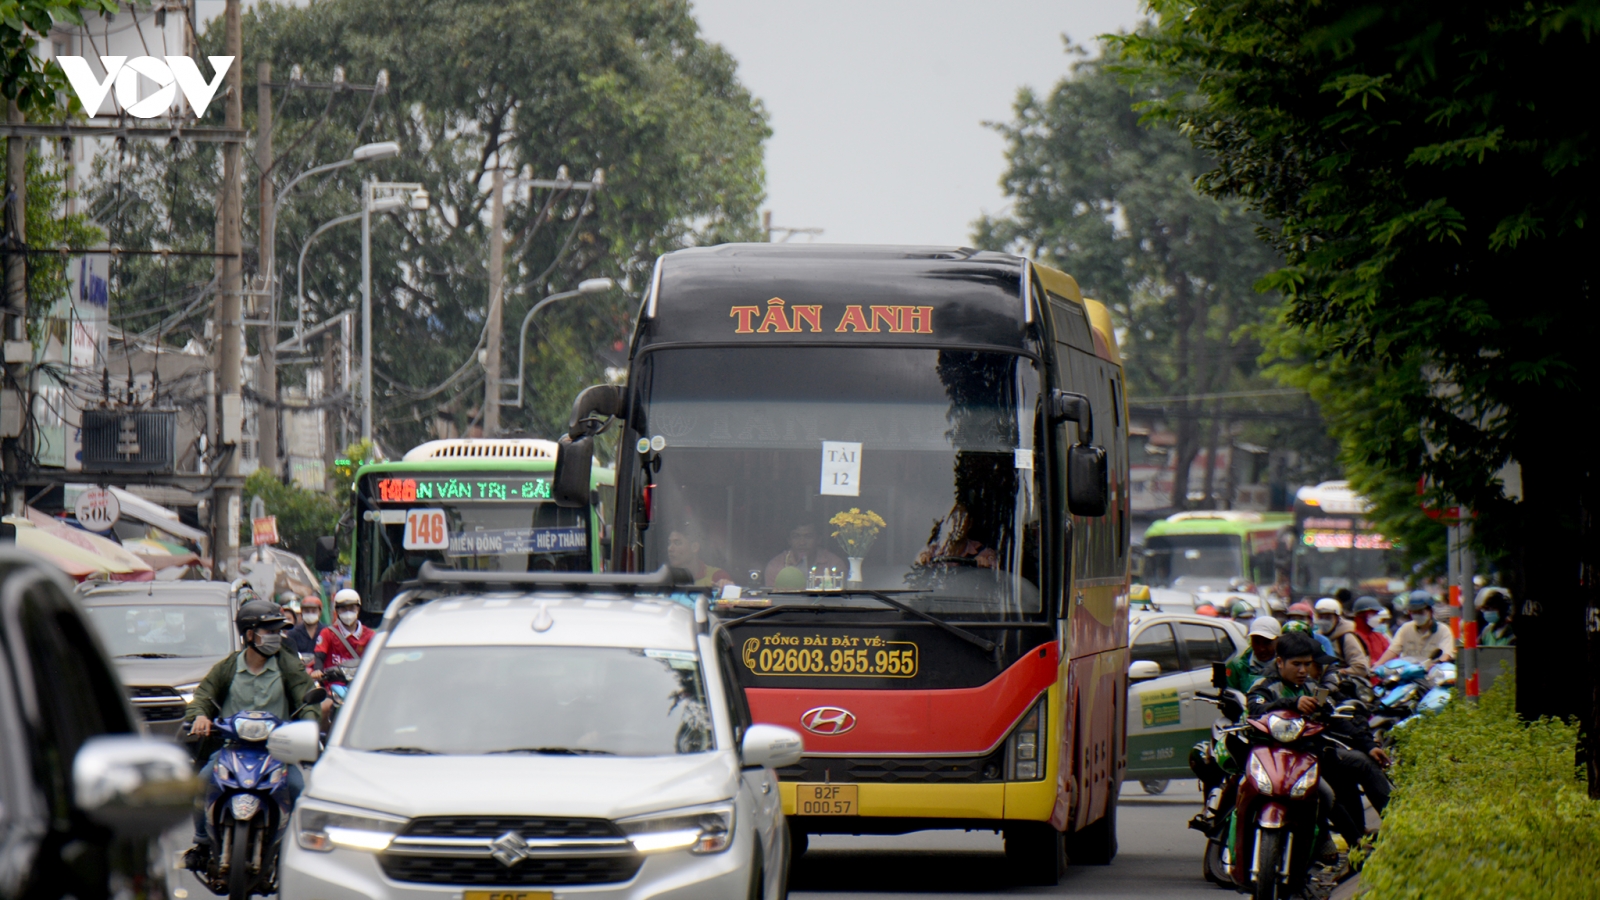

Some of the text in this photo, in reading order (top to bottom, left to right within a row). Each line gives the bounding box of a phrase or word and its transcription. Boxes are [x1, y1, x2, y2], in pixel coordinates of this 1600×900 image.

[730, 297, 934, 333] TÂN ANH
[828, 447, 857, 463] TÀI
[832, 472, 849, 486] 12
[378, 479, 417, 501] 146
[437, 478, 472, 498] VĂN
[477, 482, 506, 500] TRỊ
[408, 513, 444, 544] 146
[475, 532, 502, 551] ĐÔNG
[536, 530, 587, 550] HIỆP THÀNH
[762, 632, 886, 648] TỔNG ĐÀI ĐẶT VÉ:
[759, 648, 914, 674] 02603.955.955
[814, 787, 840, 799] 82F
[803, 801, 851, 814] 000.57
